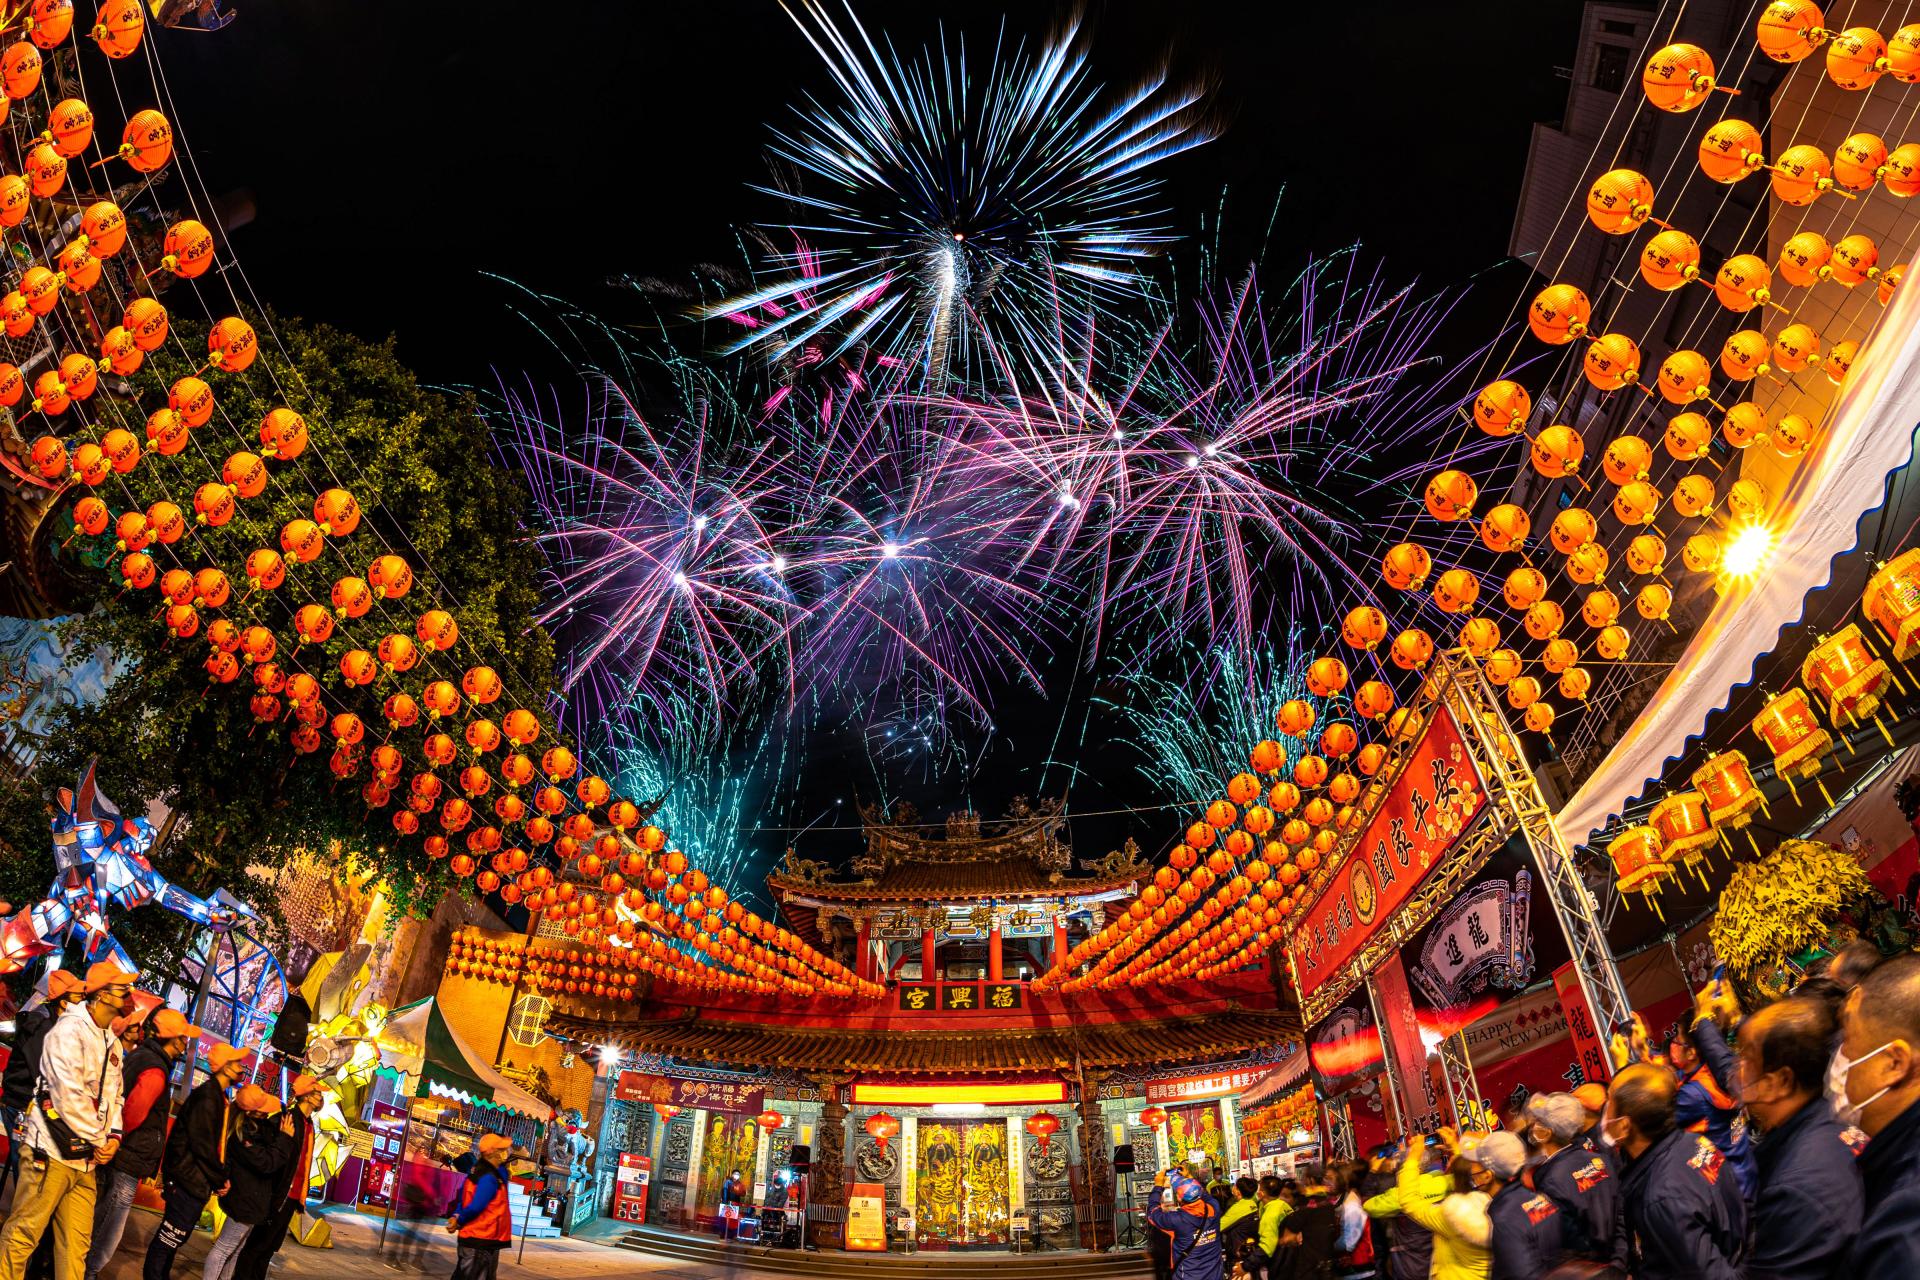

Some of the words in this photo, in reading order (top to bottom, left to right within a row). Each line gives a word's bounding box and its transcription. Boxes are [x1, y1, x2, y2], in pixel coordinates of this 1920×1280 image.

[1466, 1021, 1514, 1046] HAPPY
[1499, 1031, 1533, 1050] NEW
[1570, 1006, 1606, 1083] 龍門
